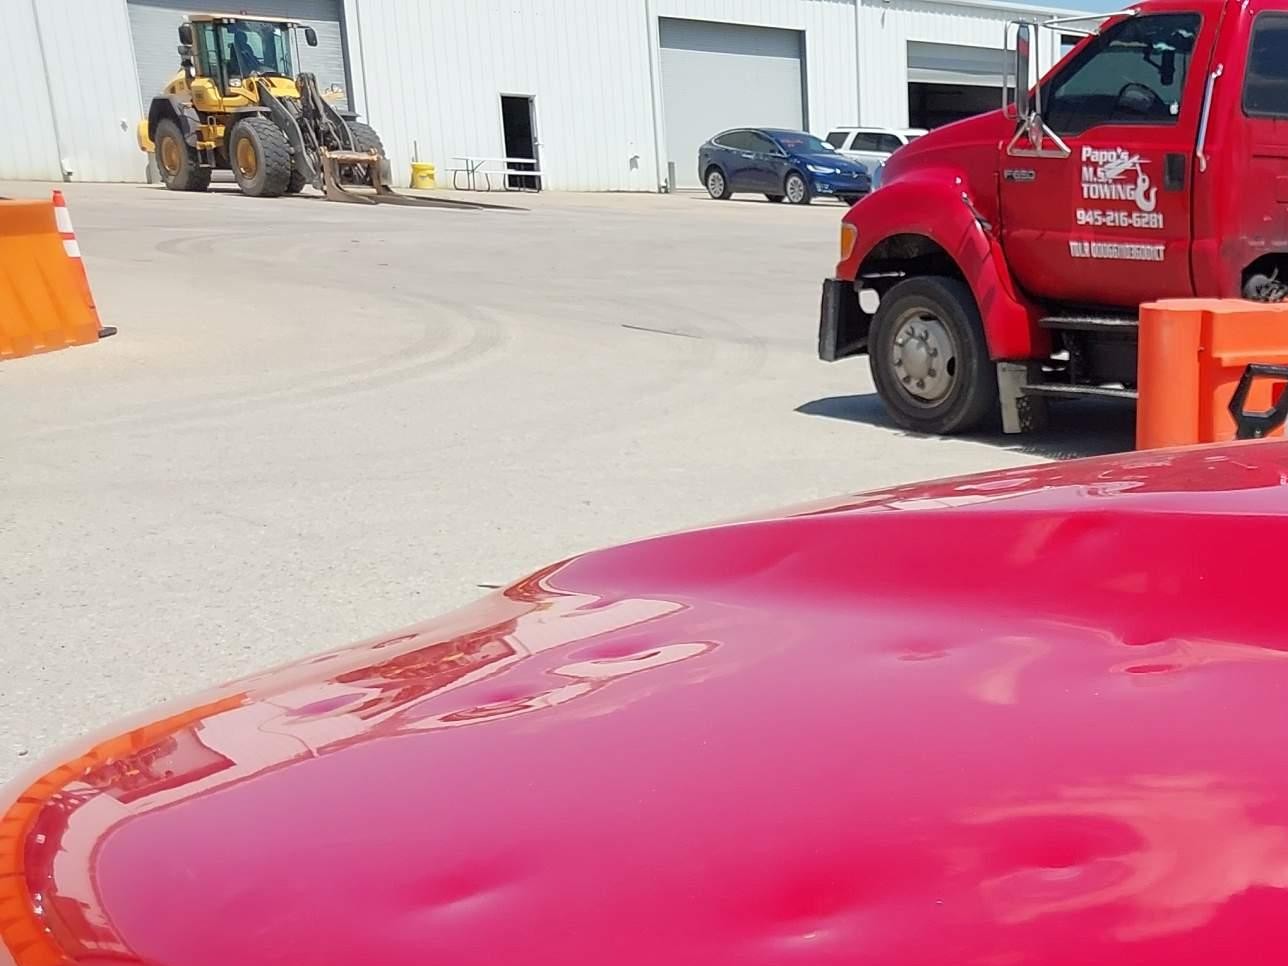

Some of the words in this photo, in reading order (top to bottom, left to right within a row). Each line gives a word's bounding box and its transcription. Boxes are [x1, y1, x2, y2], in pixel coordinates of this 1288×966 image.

[1081, 145, 1129, 165] Papo's
[1081, 183, 1136, 200] TOWING
[1076, 208, 1164, 228] 945-216-6281
